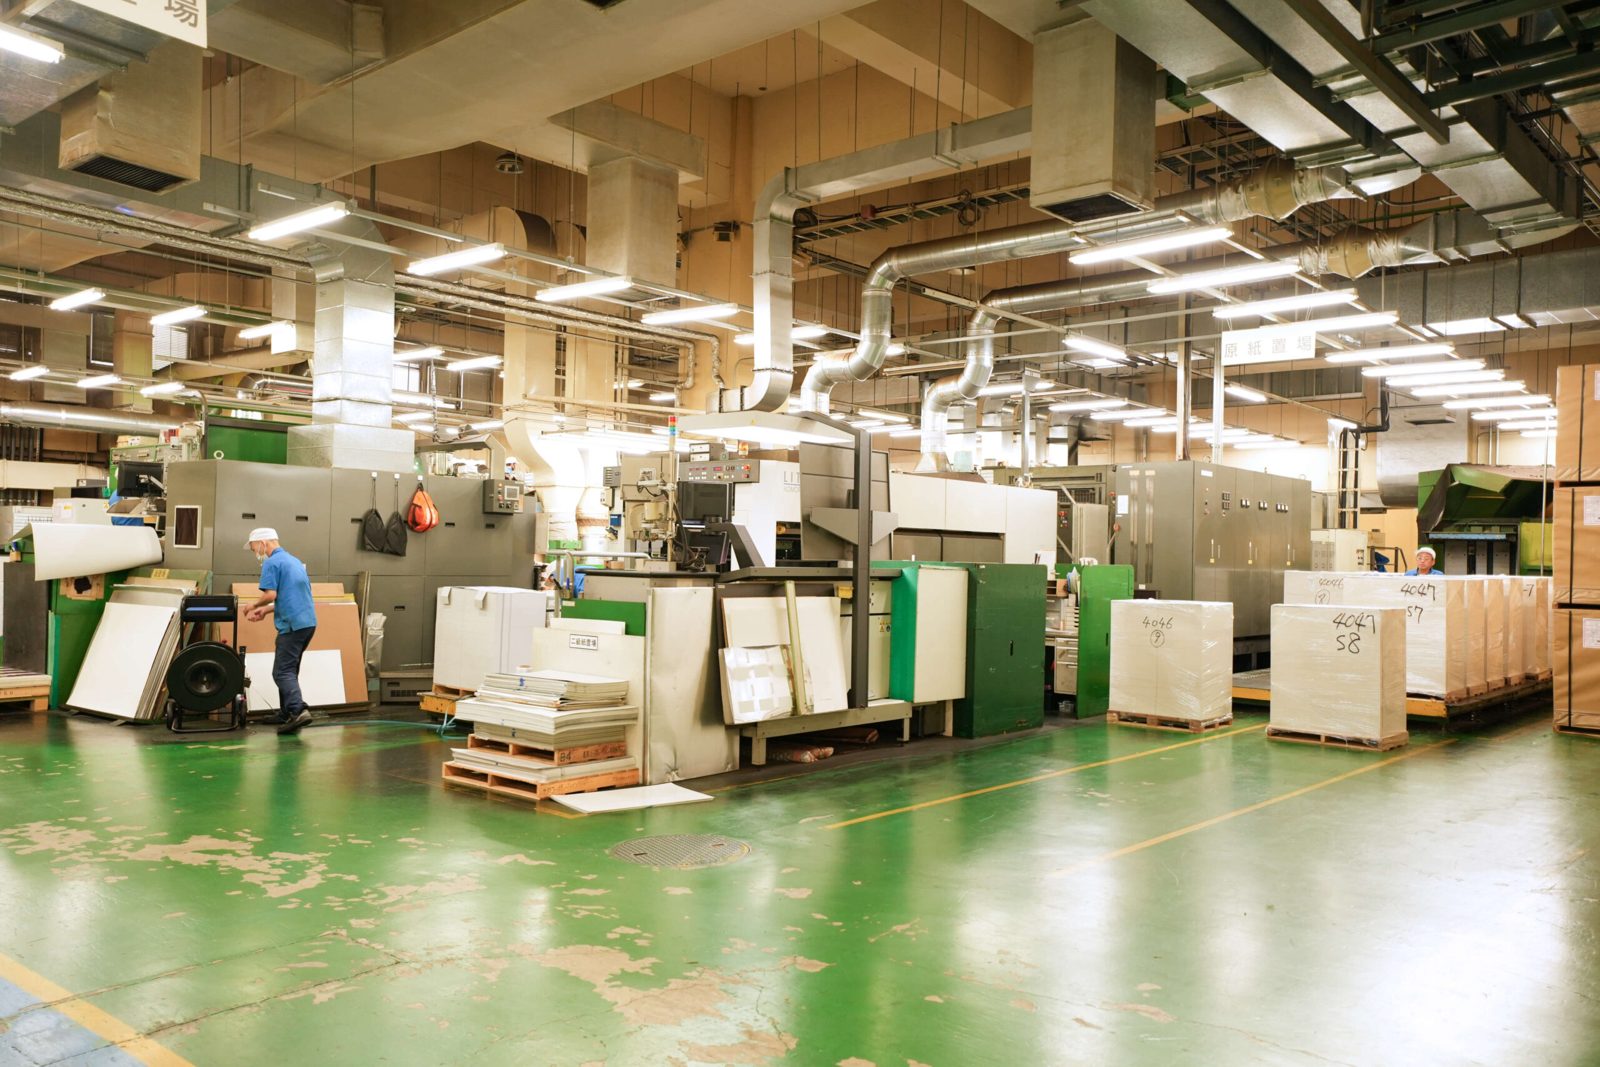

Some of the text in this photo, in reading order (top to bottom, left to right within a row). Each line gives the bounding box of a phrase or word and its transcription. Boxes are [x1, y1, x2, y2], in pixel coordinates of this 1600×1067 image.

[1224, 335, 1312, 358] 原紙置場
[1400, 582, 1436, 601] 4047
[1142, 616, 1174, 629] 4046
[1332, 612, 1376, 634] 4047
